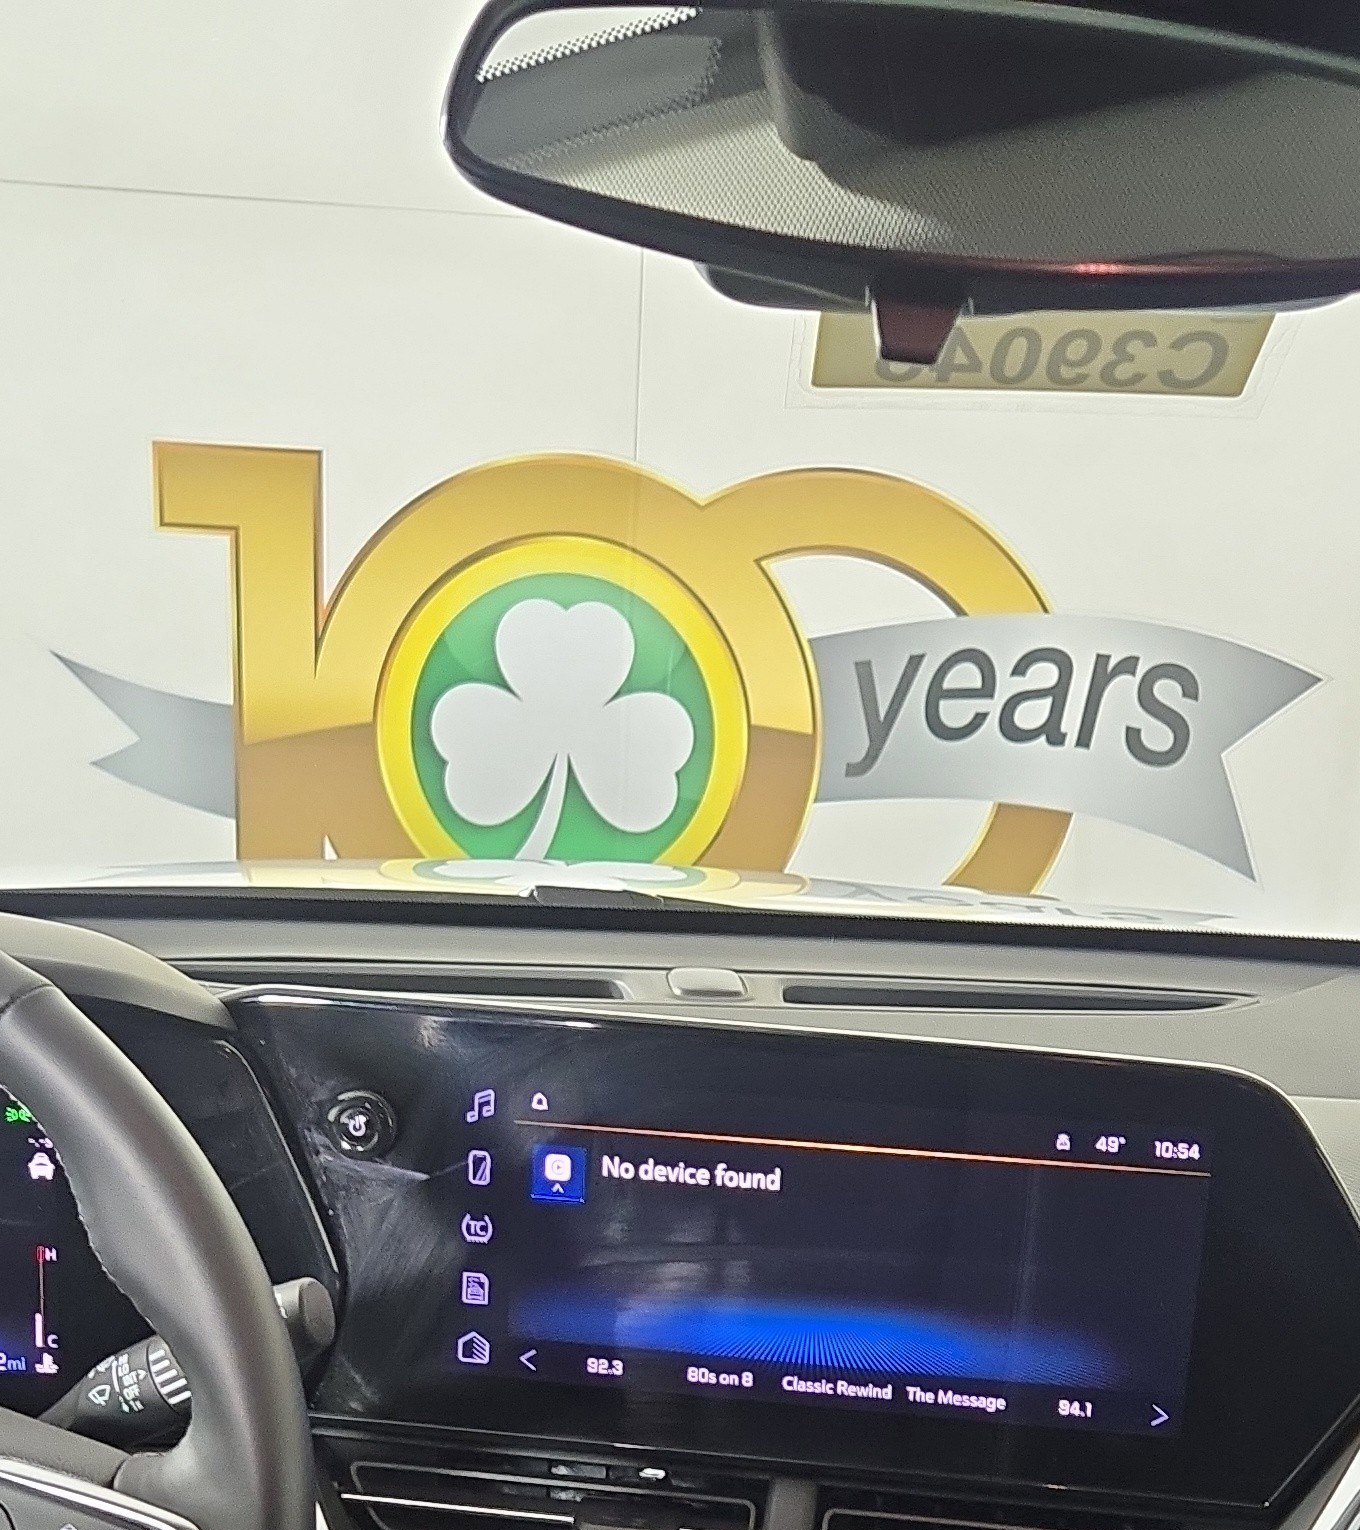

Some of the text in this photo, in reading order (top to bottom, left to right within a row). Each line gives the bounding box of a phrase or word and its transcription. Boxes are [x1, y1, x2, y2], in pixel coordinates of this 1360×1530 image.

[844, 647, 1200, 778] years
[1154, 1140, 1201, 1160] 10:54
[601, 1154, 782, 1191] No device found
[44, 1247, 57, 1261] H
[47, 1334, 59, 1349] C
[586, 1357, 624, 1376] 92.3
[687, 1366, 754, 1387] 80s on 8
[782, 1375, 893, 1400] Classic Rewind
[906, 1385, 1007, 1413] The Message
[1058, 1400, 1093, 1418] 94.1
